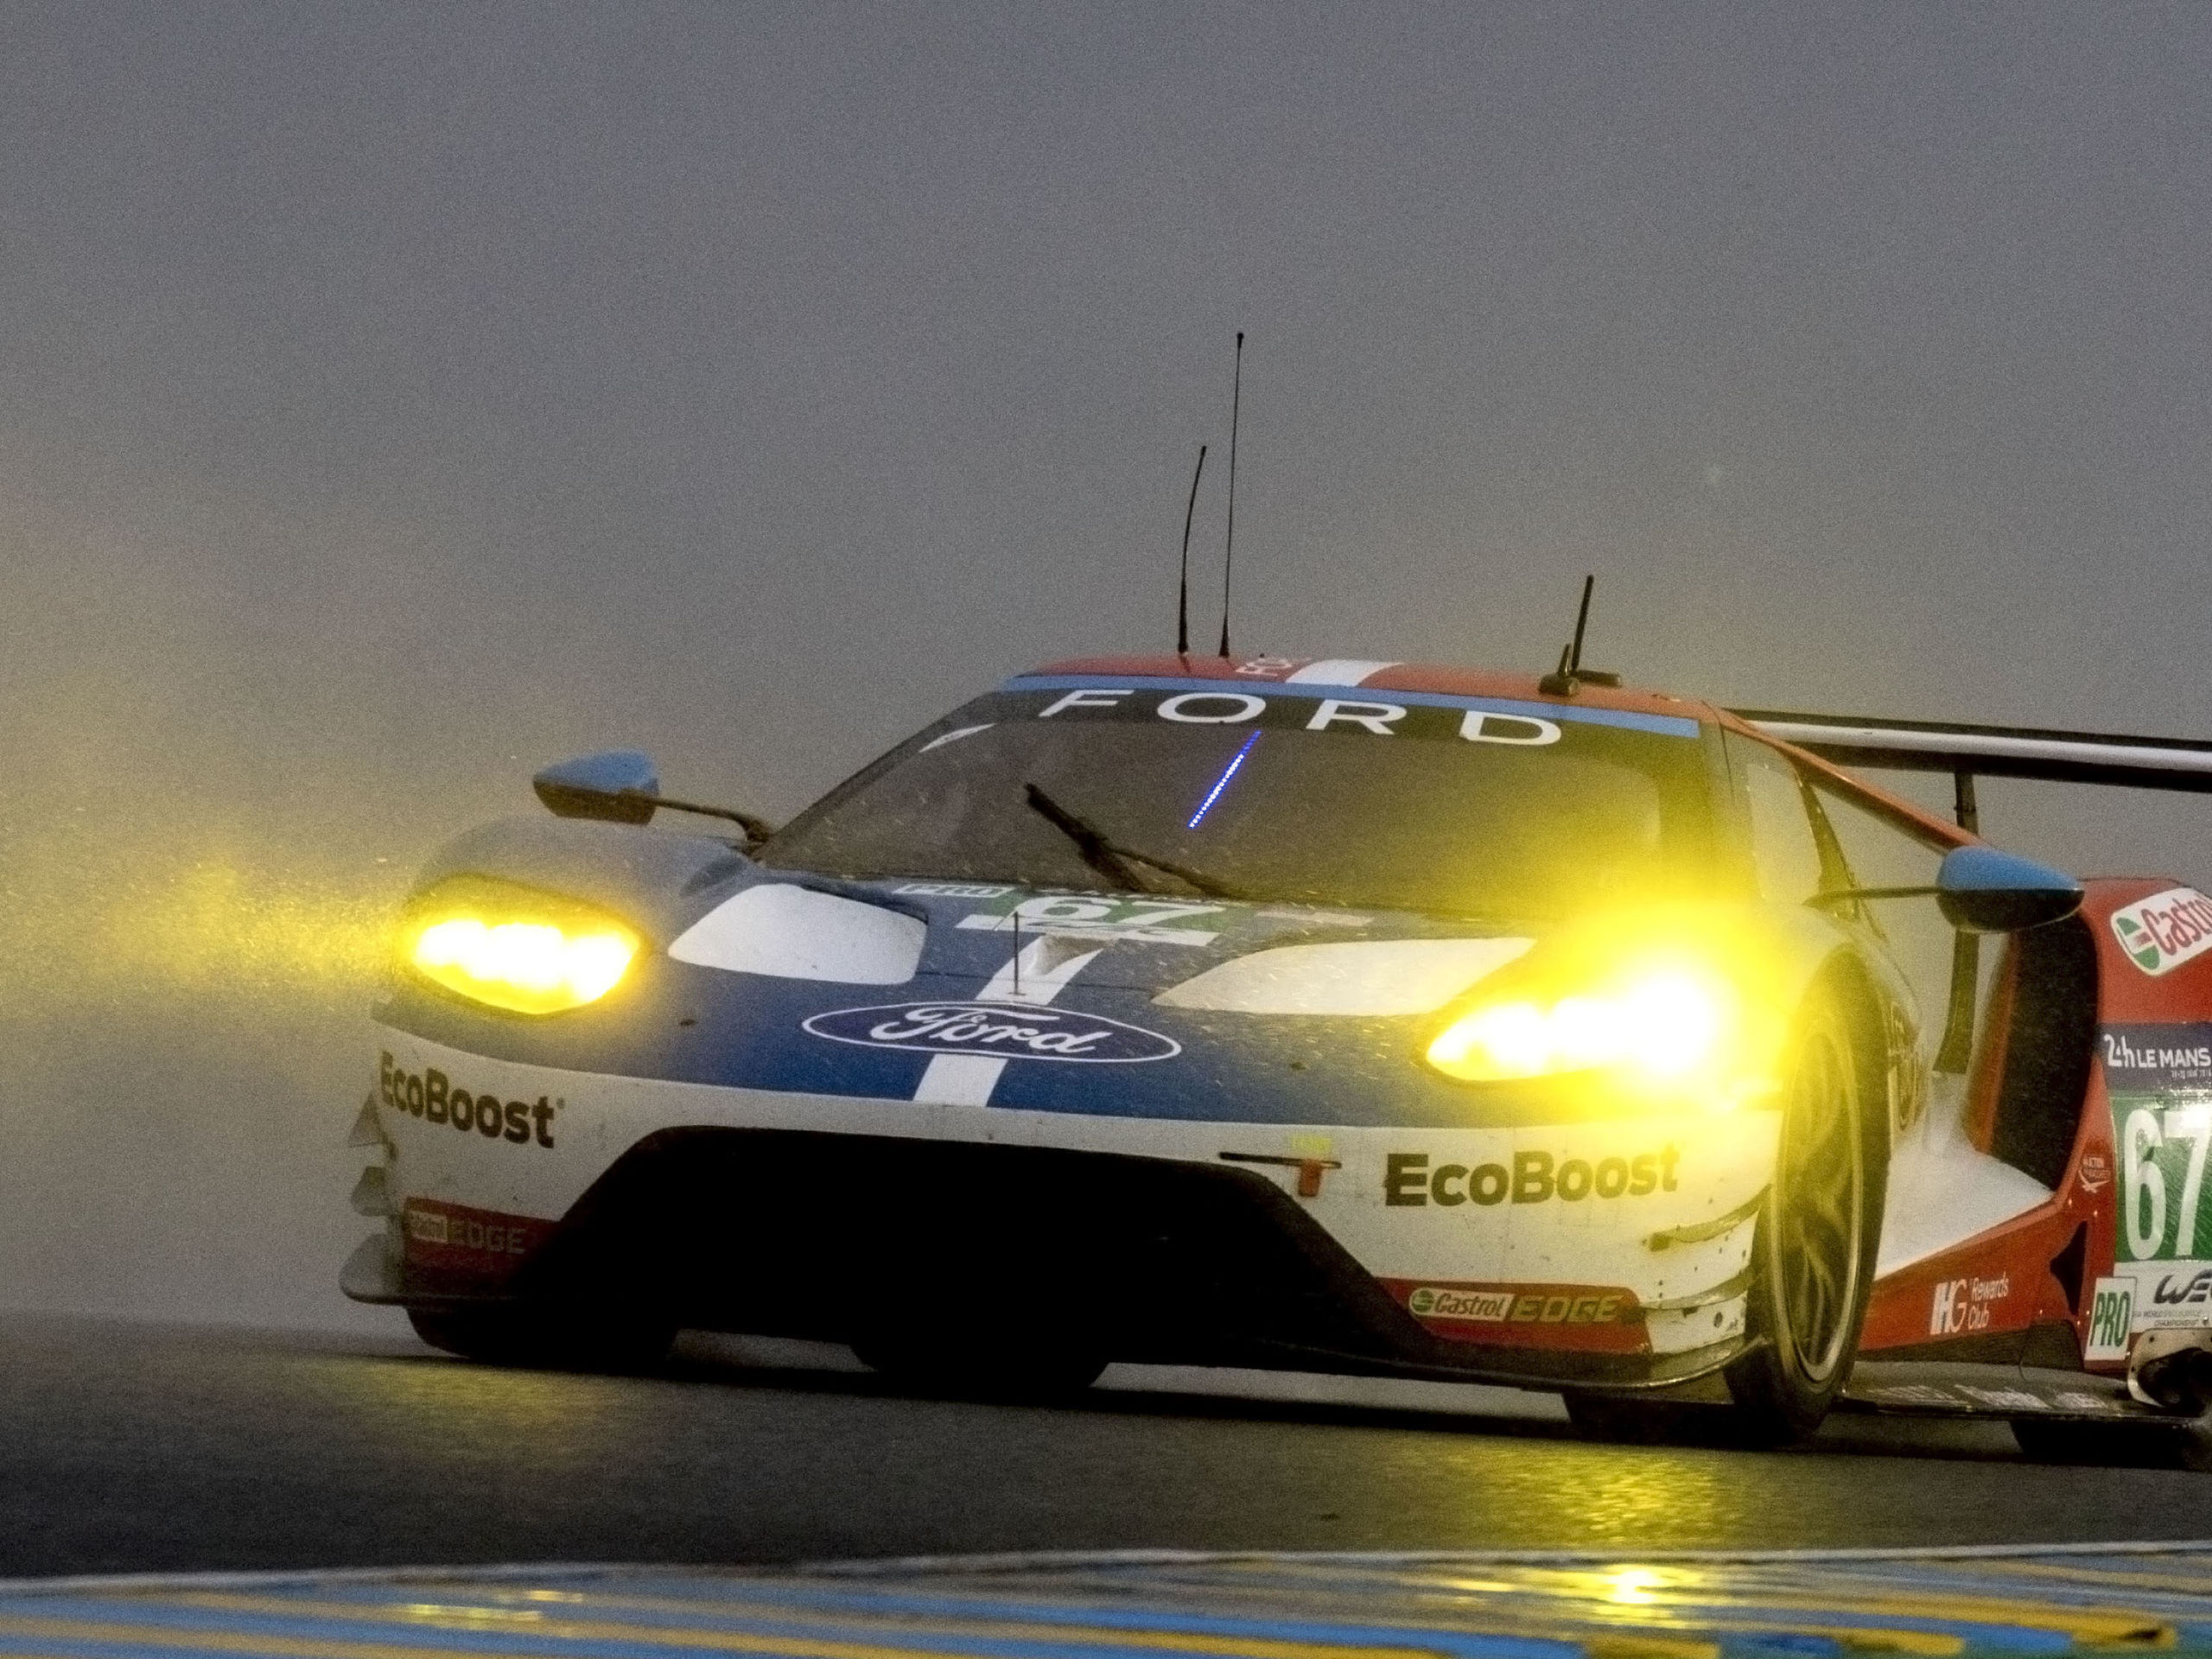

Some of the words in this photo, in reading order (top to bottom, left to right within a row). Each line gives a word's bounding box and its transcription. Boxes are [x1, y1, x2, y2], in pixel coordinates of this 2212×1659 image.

[1039, 690, 1561, 745] FORD
[2140, 898, 2212, 956] Castro
[869, 1004, 1113, 1053] Ford
[2136, 1048, 2158, 1068] LE
[2158, 1046, 2212, 1068] MANS
[380, 1051, 555, 1149] EcoBoost
[1385, 1142, 1680, 1207] EcoBoost
[2124, 1109, 2212, 1261] 67
[1434, 1294, 1505, 1317] Castrol
[1511, 1295, 1623, 1322] EDGE
[2153, 1268, 2212, 1305] WE
[2089, 1291, 2131, 1347] PRO
